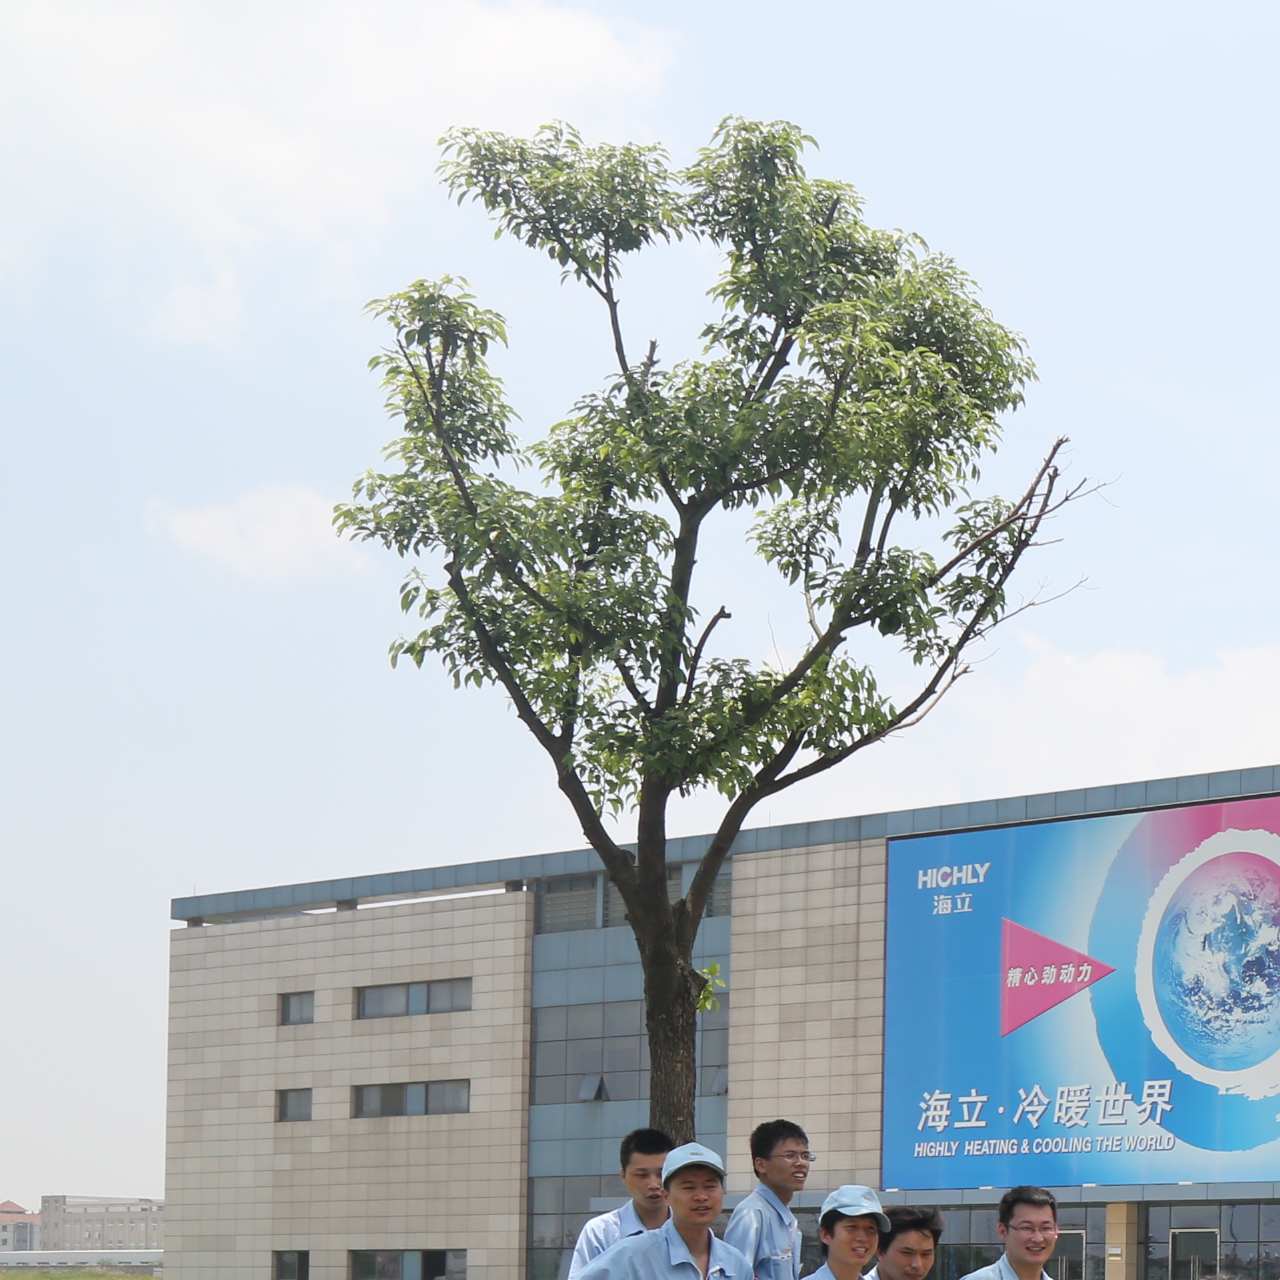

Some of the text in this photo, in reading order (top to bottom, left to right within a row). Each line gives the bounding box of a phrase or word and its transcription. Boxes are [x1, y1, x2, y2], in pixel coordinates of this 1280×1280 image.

[917, 862, 991, 889] HIGHLY
[932, 893, 973, 915] 海立
[1006, 962, 1092, 987] 精心劲动力
[914, 1134, 1176, 1157] HIGHLY HEATING & COOLING THE WORLD
